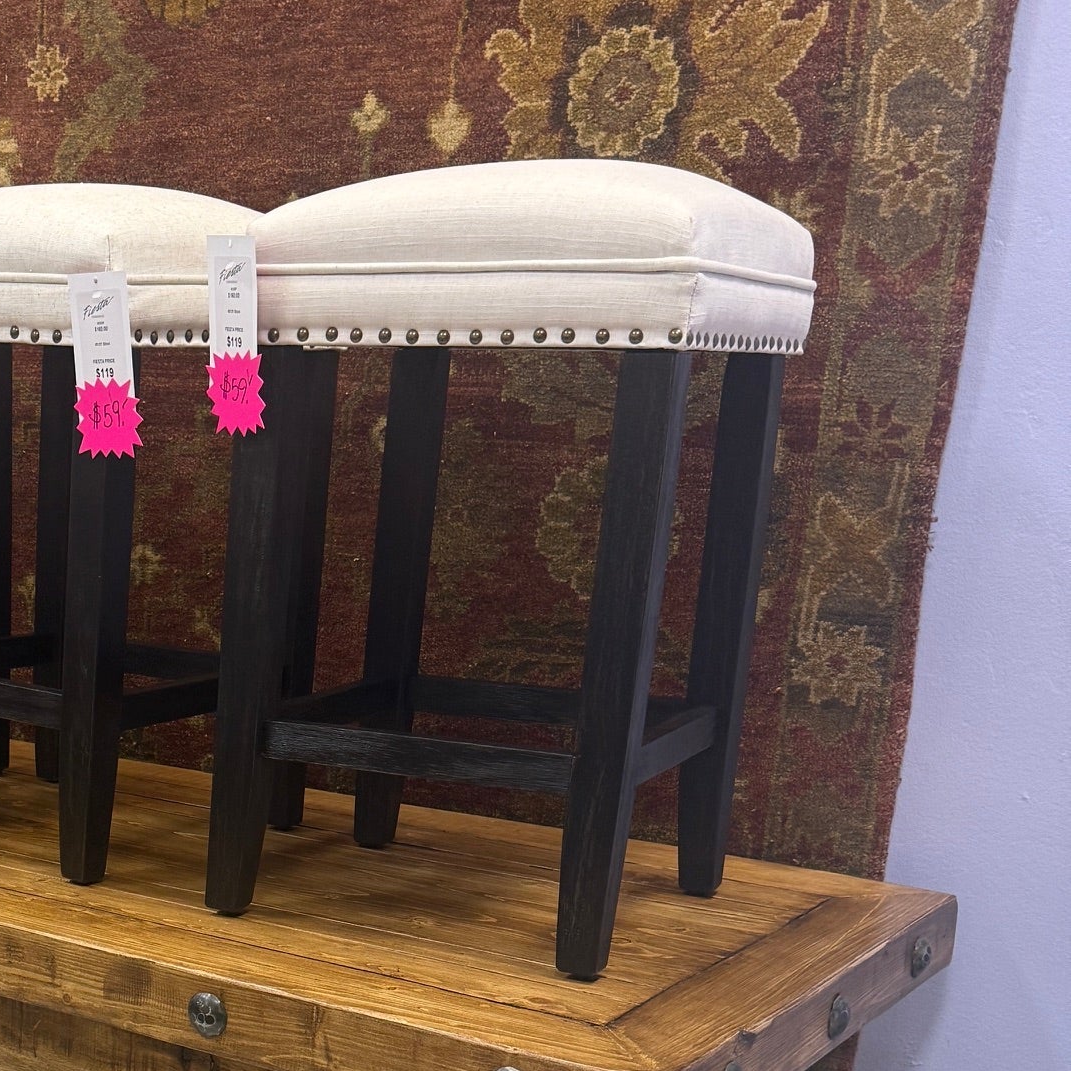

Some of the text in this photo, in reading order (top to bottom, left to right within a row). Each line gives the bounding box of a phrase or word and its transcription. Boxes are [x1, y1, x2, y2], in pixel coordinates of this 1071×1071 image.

[82, 295, 114, 321] Fiesta
[226, 335, 242, 348] $119
[95, 367, 114, 378] $119
